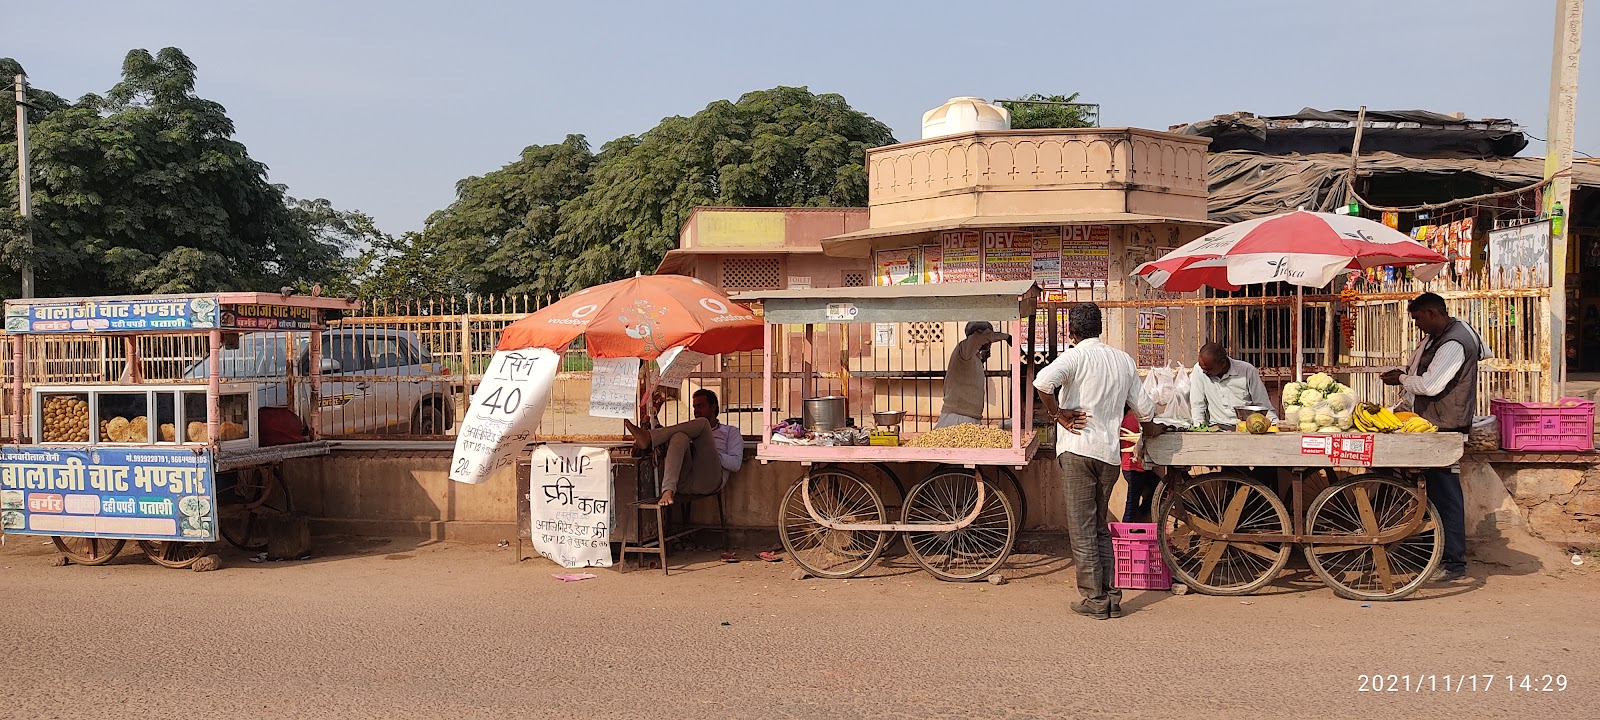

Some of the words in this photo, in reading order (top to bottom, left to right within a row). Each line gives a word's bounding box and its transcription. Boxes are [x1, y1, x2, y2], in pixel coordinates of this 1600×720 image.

[944, 232, 966, 249] DEV
[985, 232, 1014, 249] DEV
[1062, 225, 1091, 241] DEV
[34, 301, 97, 320] बालाजी
[133, 303, 187, 317] भण्डार
[710, 314, 752, 323] vodafone
[481, 387, 521, 415] 40
[1340, 451, 1359, 460] airtel
[0, 457, 86, 491] बालाजी
[88, 465, 129, 492] चाट
[134, 466, 206, 494] भण्डार
[30, 495, 62, 511] बर्गर
[103, 498, 115, 512] दही
[139, 498, 173, 515] पताशी
[556, 536, 565, 545] 12
[591, 540, 598, 548] 6
